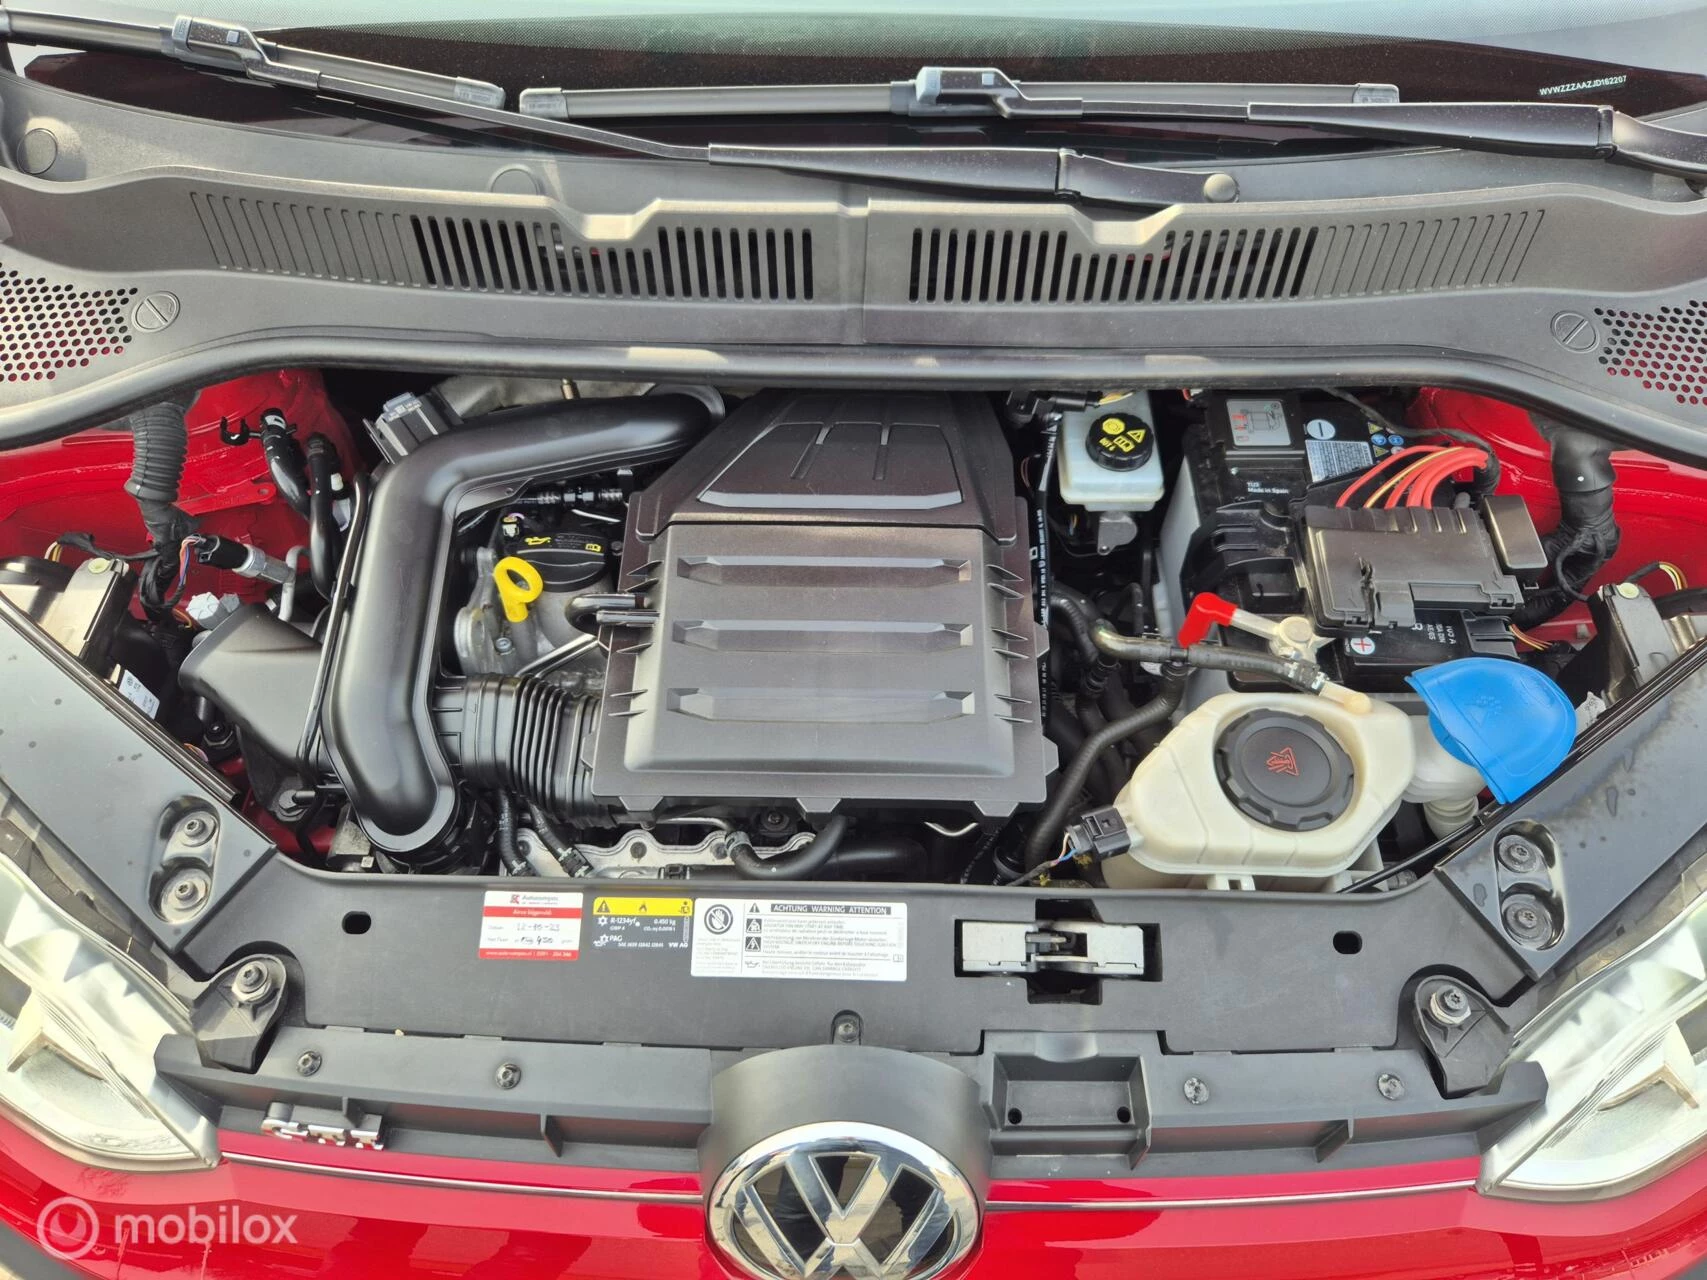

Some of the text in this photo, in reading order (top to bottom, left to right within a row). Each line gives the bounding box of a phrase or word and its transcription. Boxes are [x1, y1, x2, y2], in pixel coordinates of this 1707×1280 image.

[1539, 74, 1627, 96] WVWZZZAAZJD162207
[773, 904, 887, 914] ACHTUNG WARNING ATTENTION
